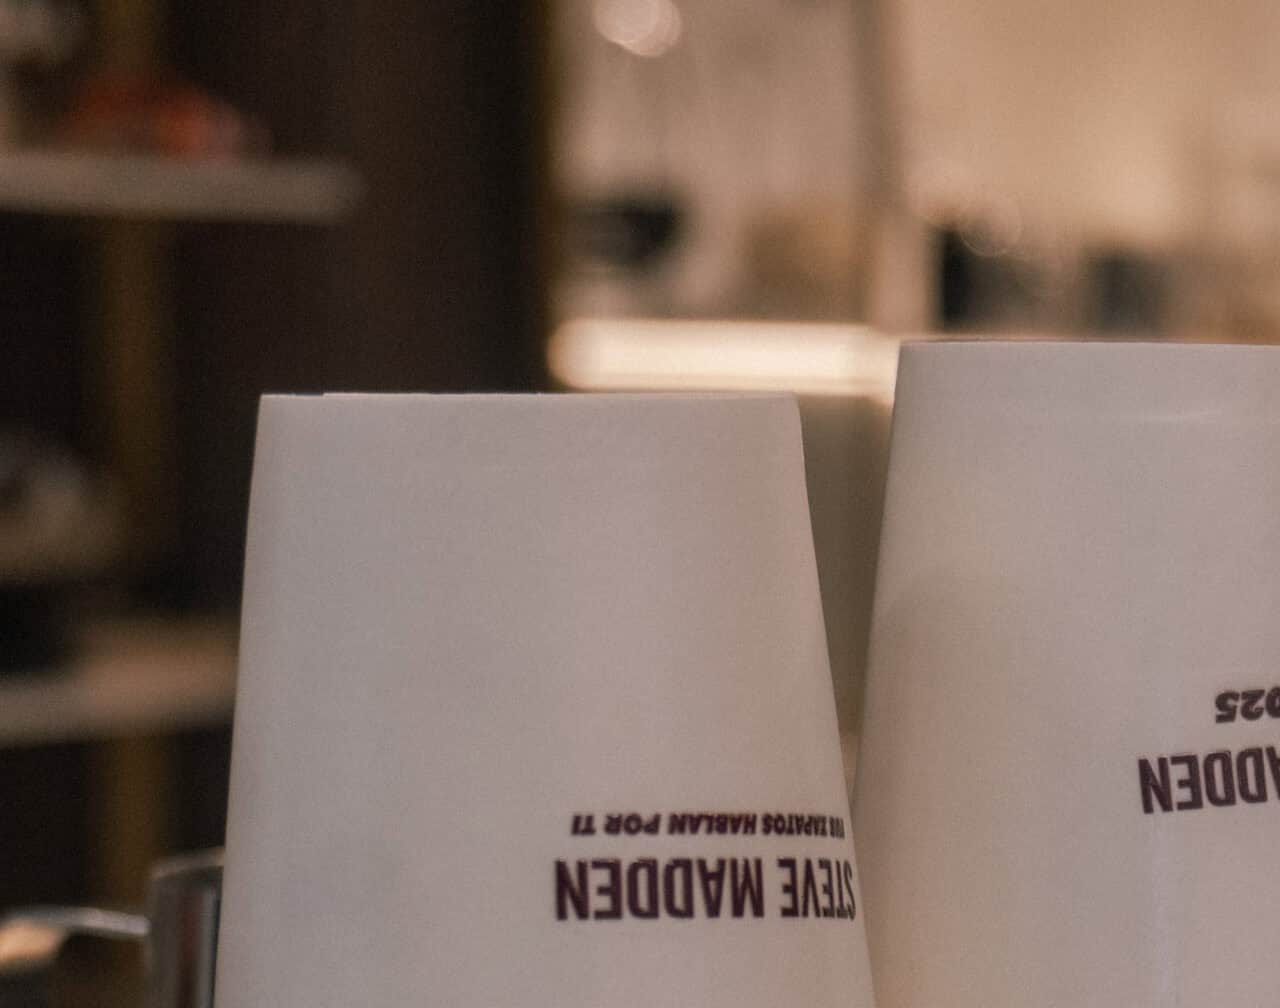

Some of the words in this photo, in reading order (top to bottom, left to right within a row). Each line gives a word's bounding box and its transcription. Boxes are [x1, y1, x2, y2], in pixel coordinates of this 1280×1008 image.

[571, 813, 597, 836] TI
[604, 813, 661, 836] POR
[668, 813, 757, 836] HABLAN
[761, 814, 828, 838] ZAPATOS
[555, 857, 765, 921] MADDEN
[776, 858, 856, 920] STEVE
